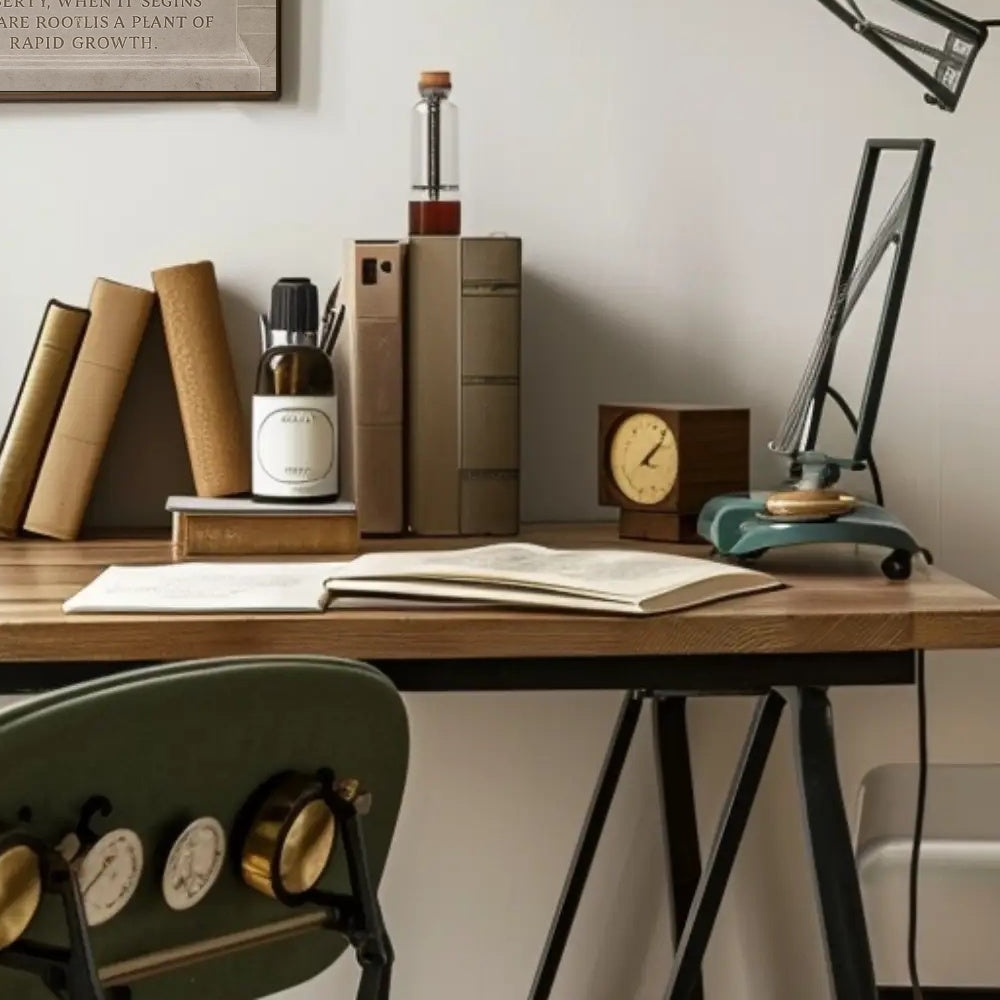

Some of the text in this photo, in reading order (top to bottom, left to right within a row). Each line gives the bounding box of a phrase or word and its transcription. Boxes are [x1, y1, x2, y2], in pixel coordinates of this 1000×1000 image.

[113, 15, 126, 29] A
[132, 15, 188, 29] PLANT
[192, 15, 215, 29] OF
[10, 36, 159, 50] RAPID GROWTH.
